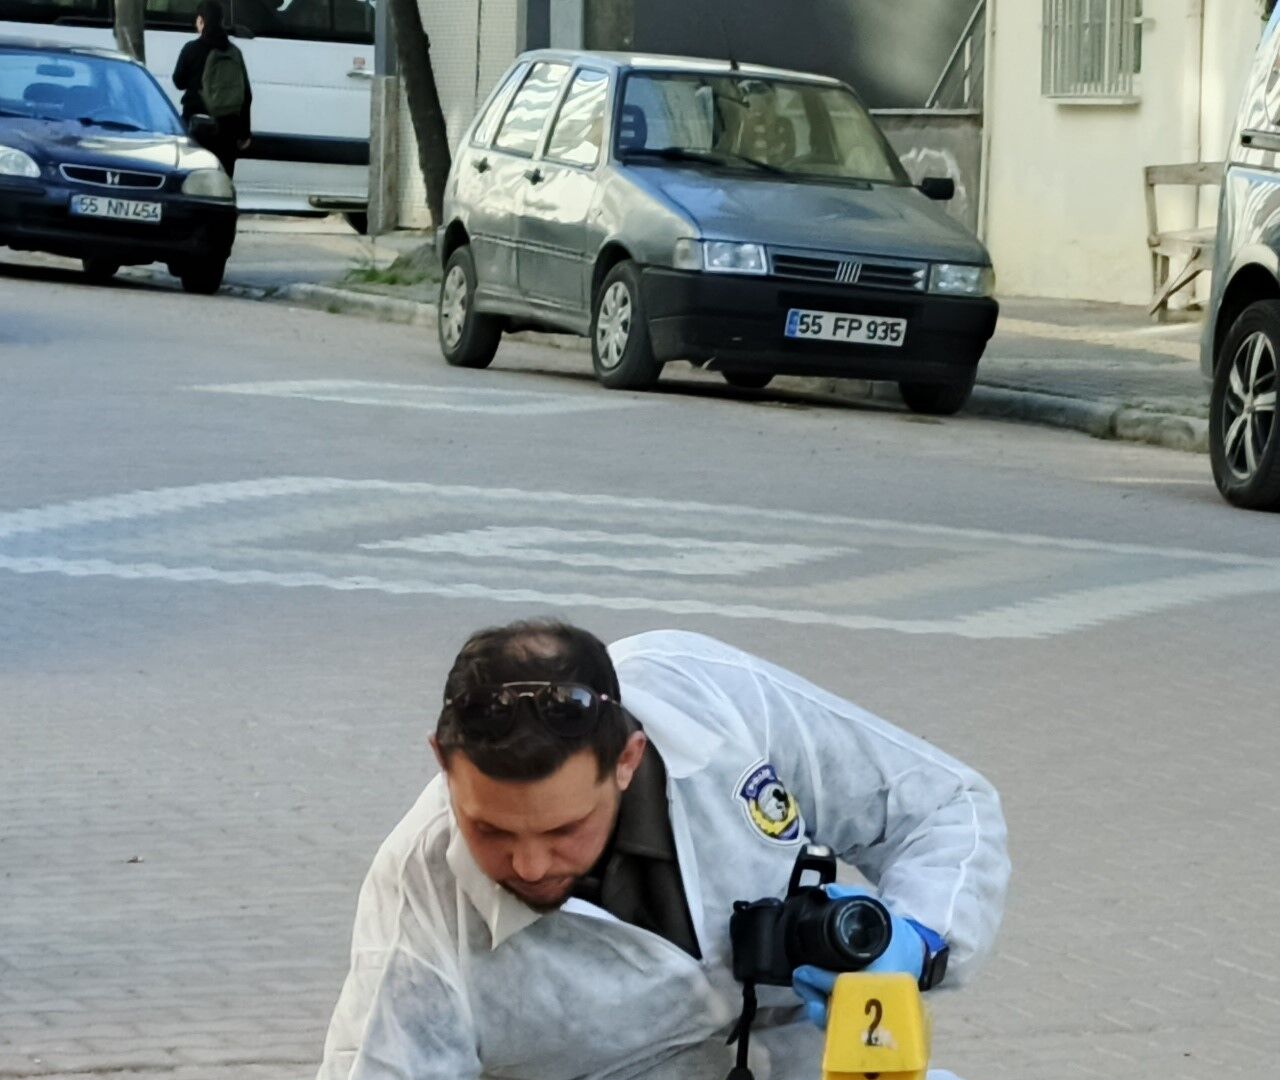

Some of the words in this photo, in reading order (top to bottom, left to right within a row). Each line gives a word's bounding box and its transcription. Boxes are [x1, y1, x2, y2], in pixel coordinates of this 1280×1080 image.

[80, 197, 98, 213] 55
[107, 200, 130, 217] NN
[799, 314, 824, 335] 55
[832, 317, 862, 338] FP
[866, 320, 902, 342] 935
[864, 998, 883, 1047] 2
